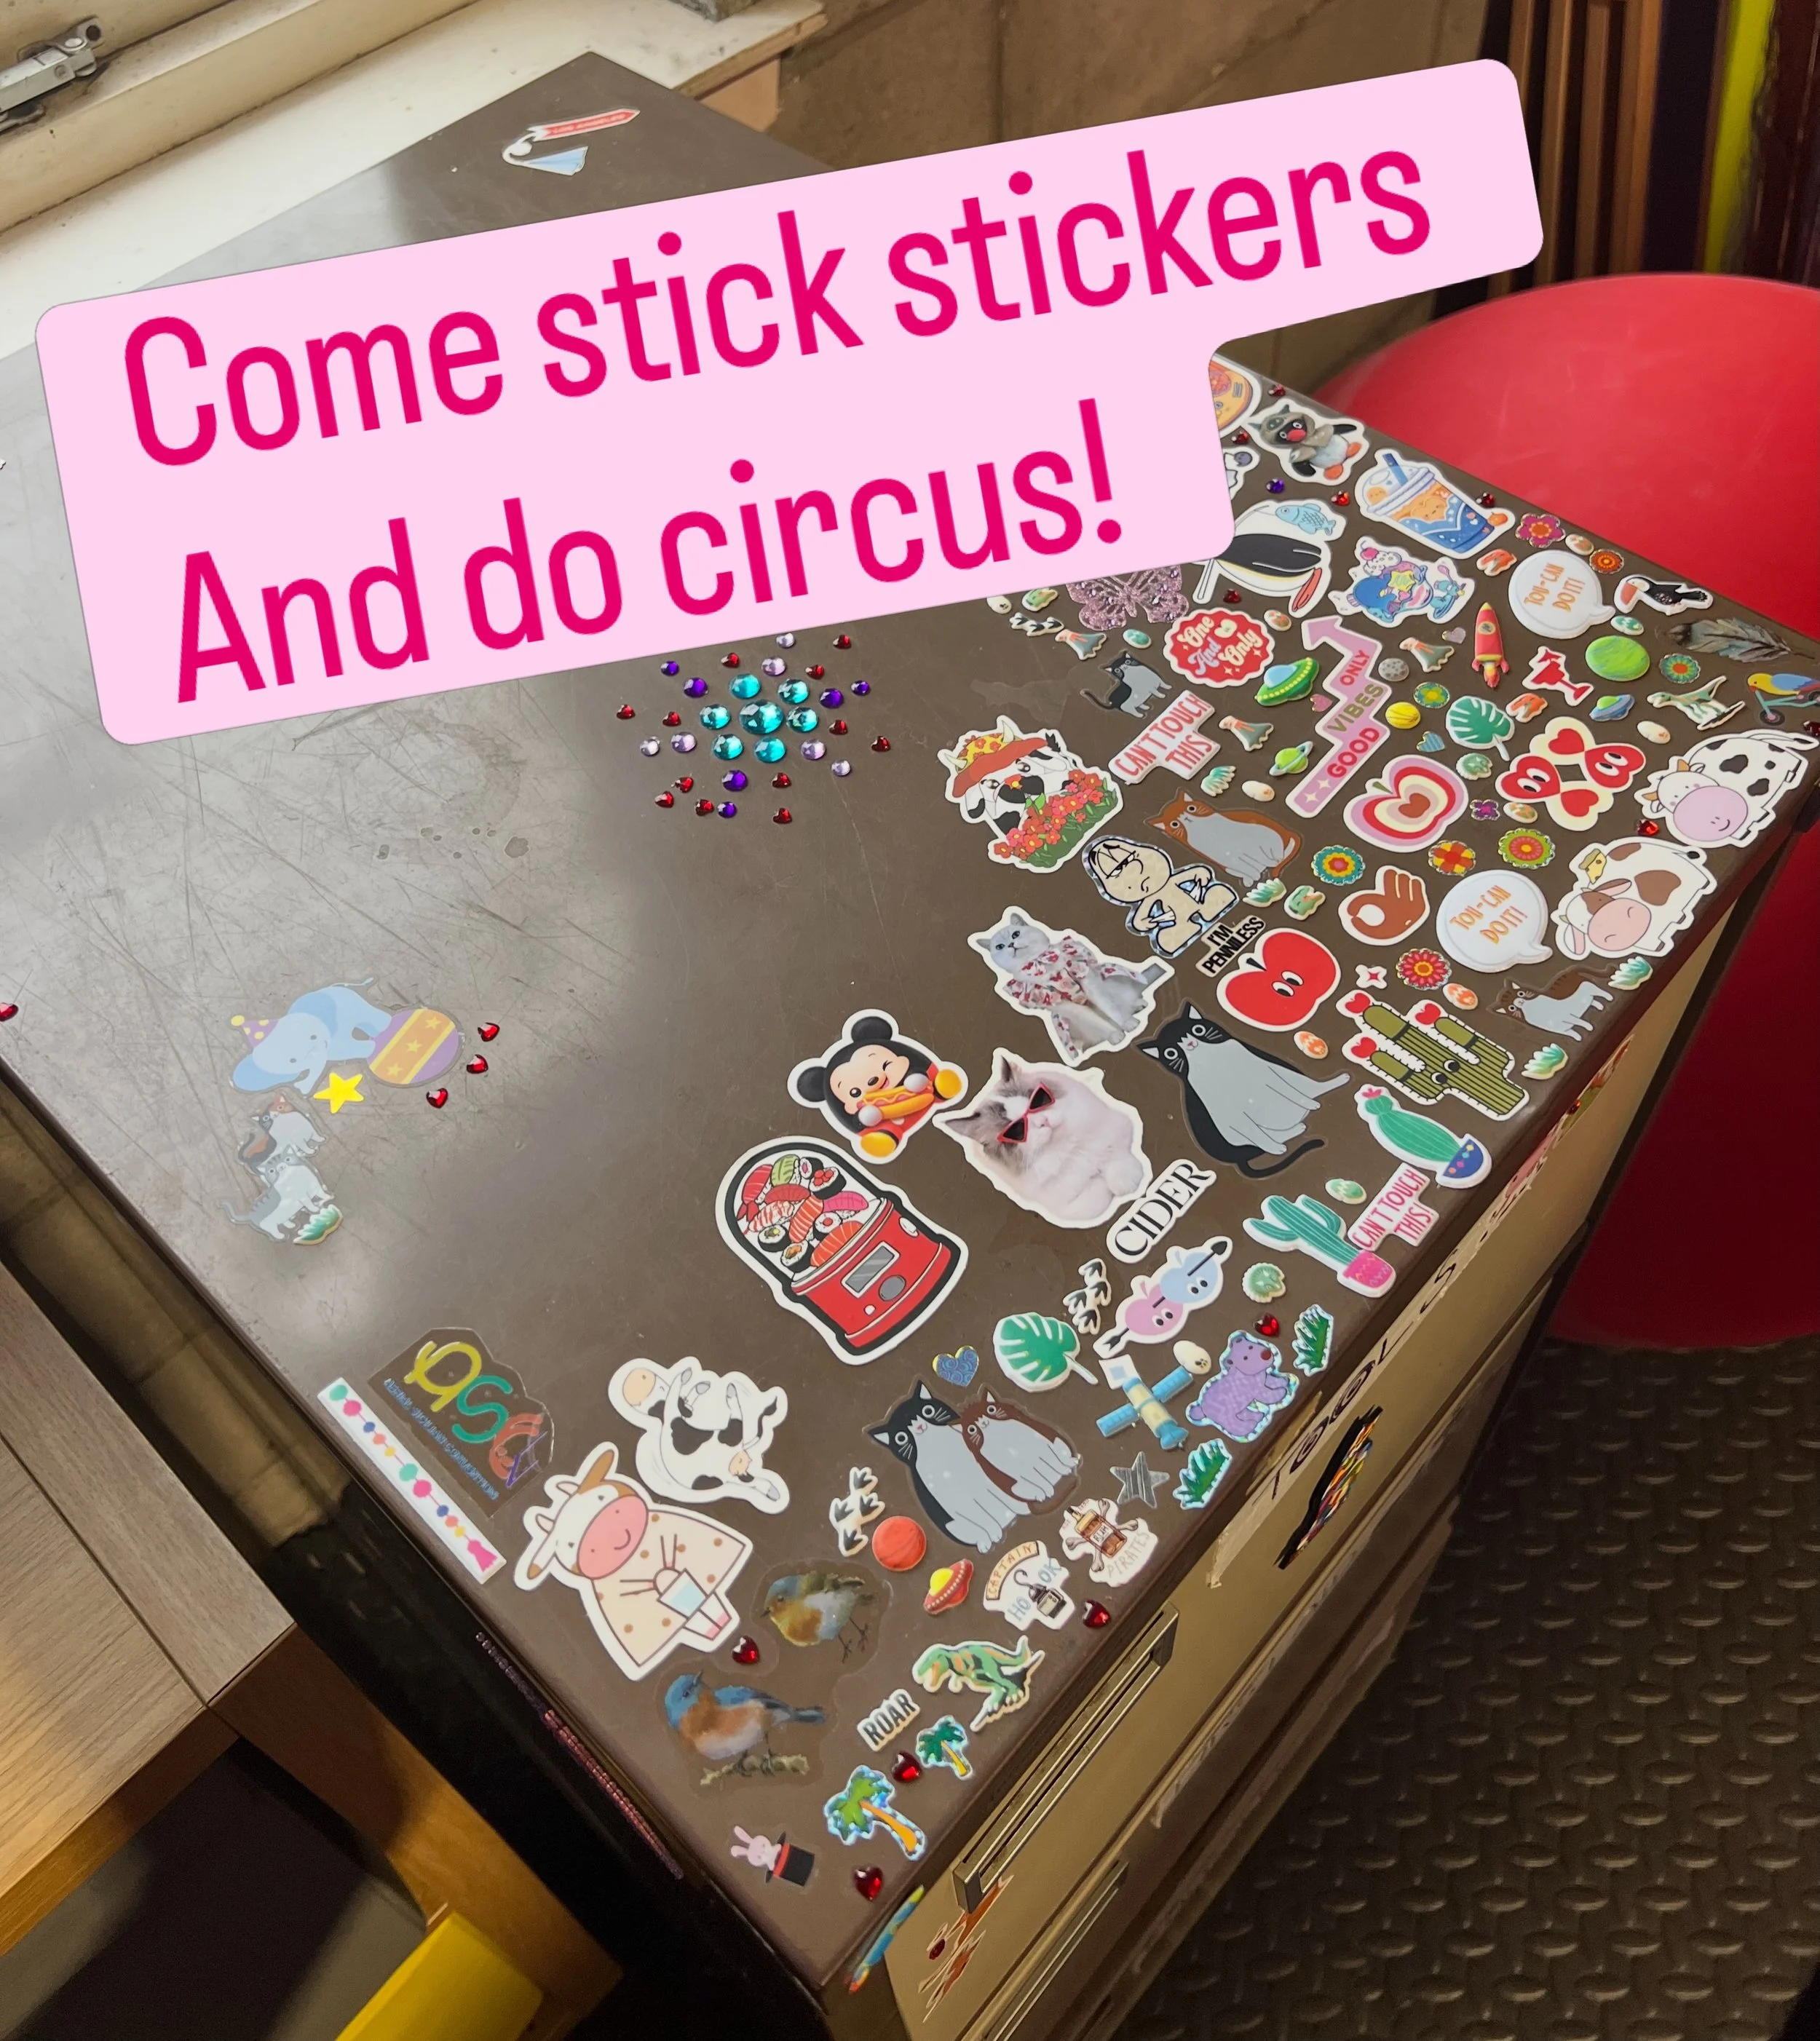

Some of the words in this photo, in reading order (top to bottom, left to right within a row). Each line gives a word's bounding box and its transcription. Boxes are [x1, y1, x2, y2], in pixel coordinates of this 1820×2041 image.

[1552, 591, 1575, 613] DO
[1176, 614, 1214, 648] One
[1217, 628, 1264, 667] Only
[1187, 636, 1222, 675] And
[1340, 649, 1371, 686] ONLY
[1326, 683, 1384, 733] VIBES
[1115, 733, 1167, 776] CAN'T
[1149, 694, 1211, 740] TOUCH
[1326, 726, 1380, 778] GOOD
[1201, 916, 1265, 974] PENNILESS
[1206, 924, 1233, 947] I'M
[1479, 920, 1509, 944] DO
[1115, 1162, 1210, 1256] CIDER
[1352, 1207, 1394, 1248] CAN'T
[1377, 1169, 1427, 1212] TOUCH
[1393, 1201, 1435, 1241] THIS!
[1252, 1248, 1458, 1505] TOOLS
[1093, 1525, 1110, 1543] RUM
[1107, 1531, 1150, 1578] PIRATES
[988, 1544, 1032, 1595] CAPTAIN
[862, 1694, 916, 1745] ROAR
